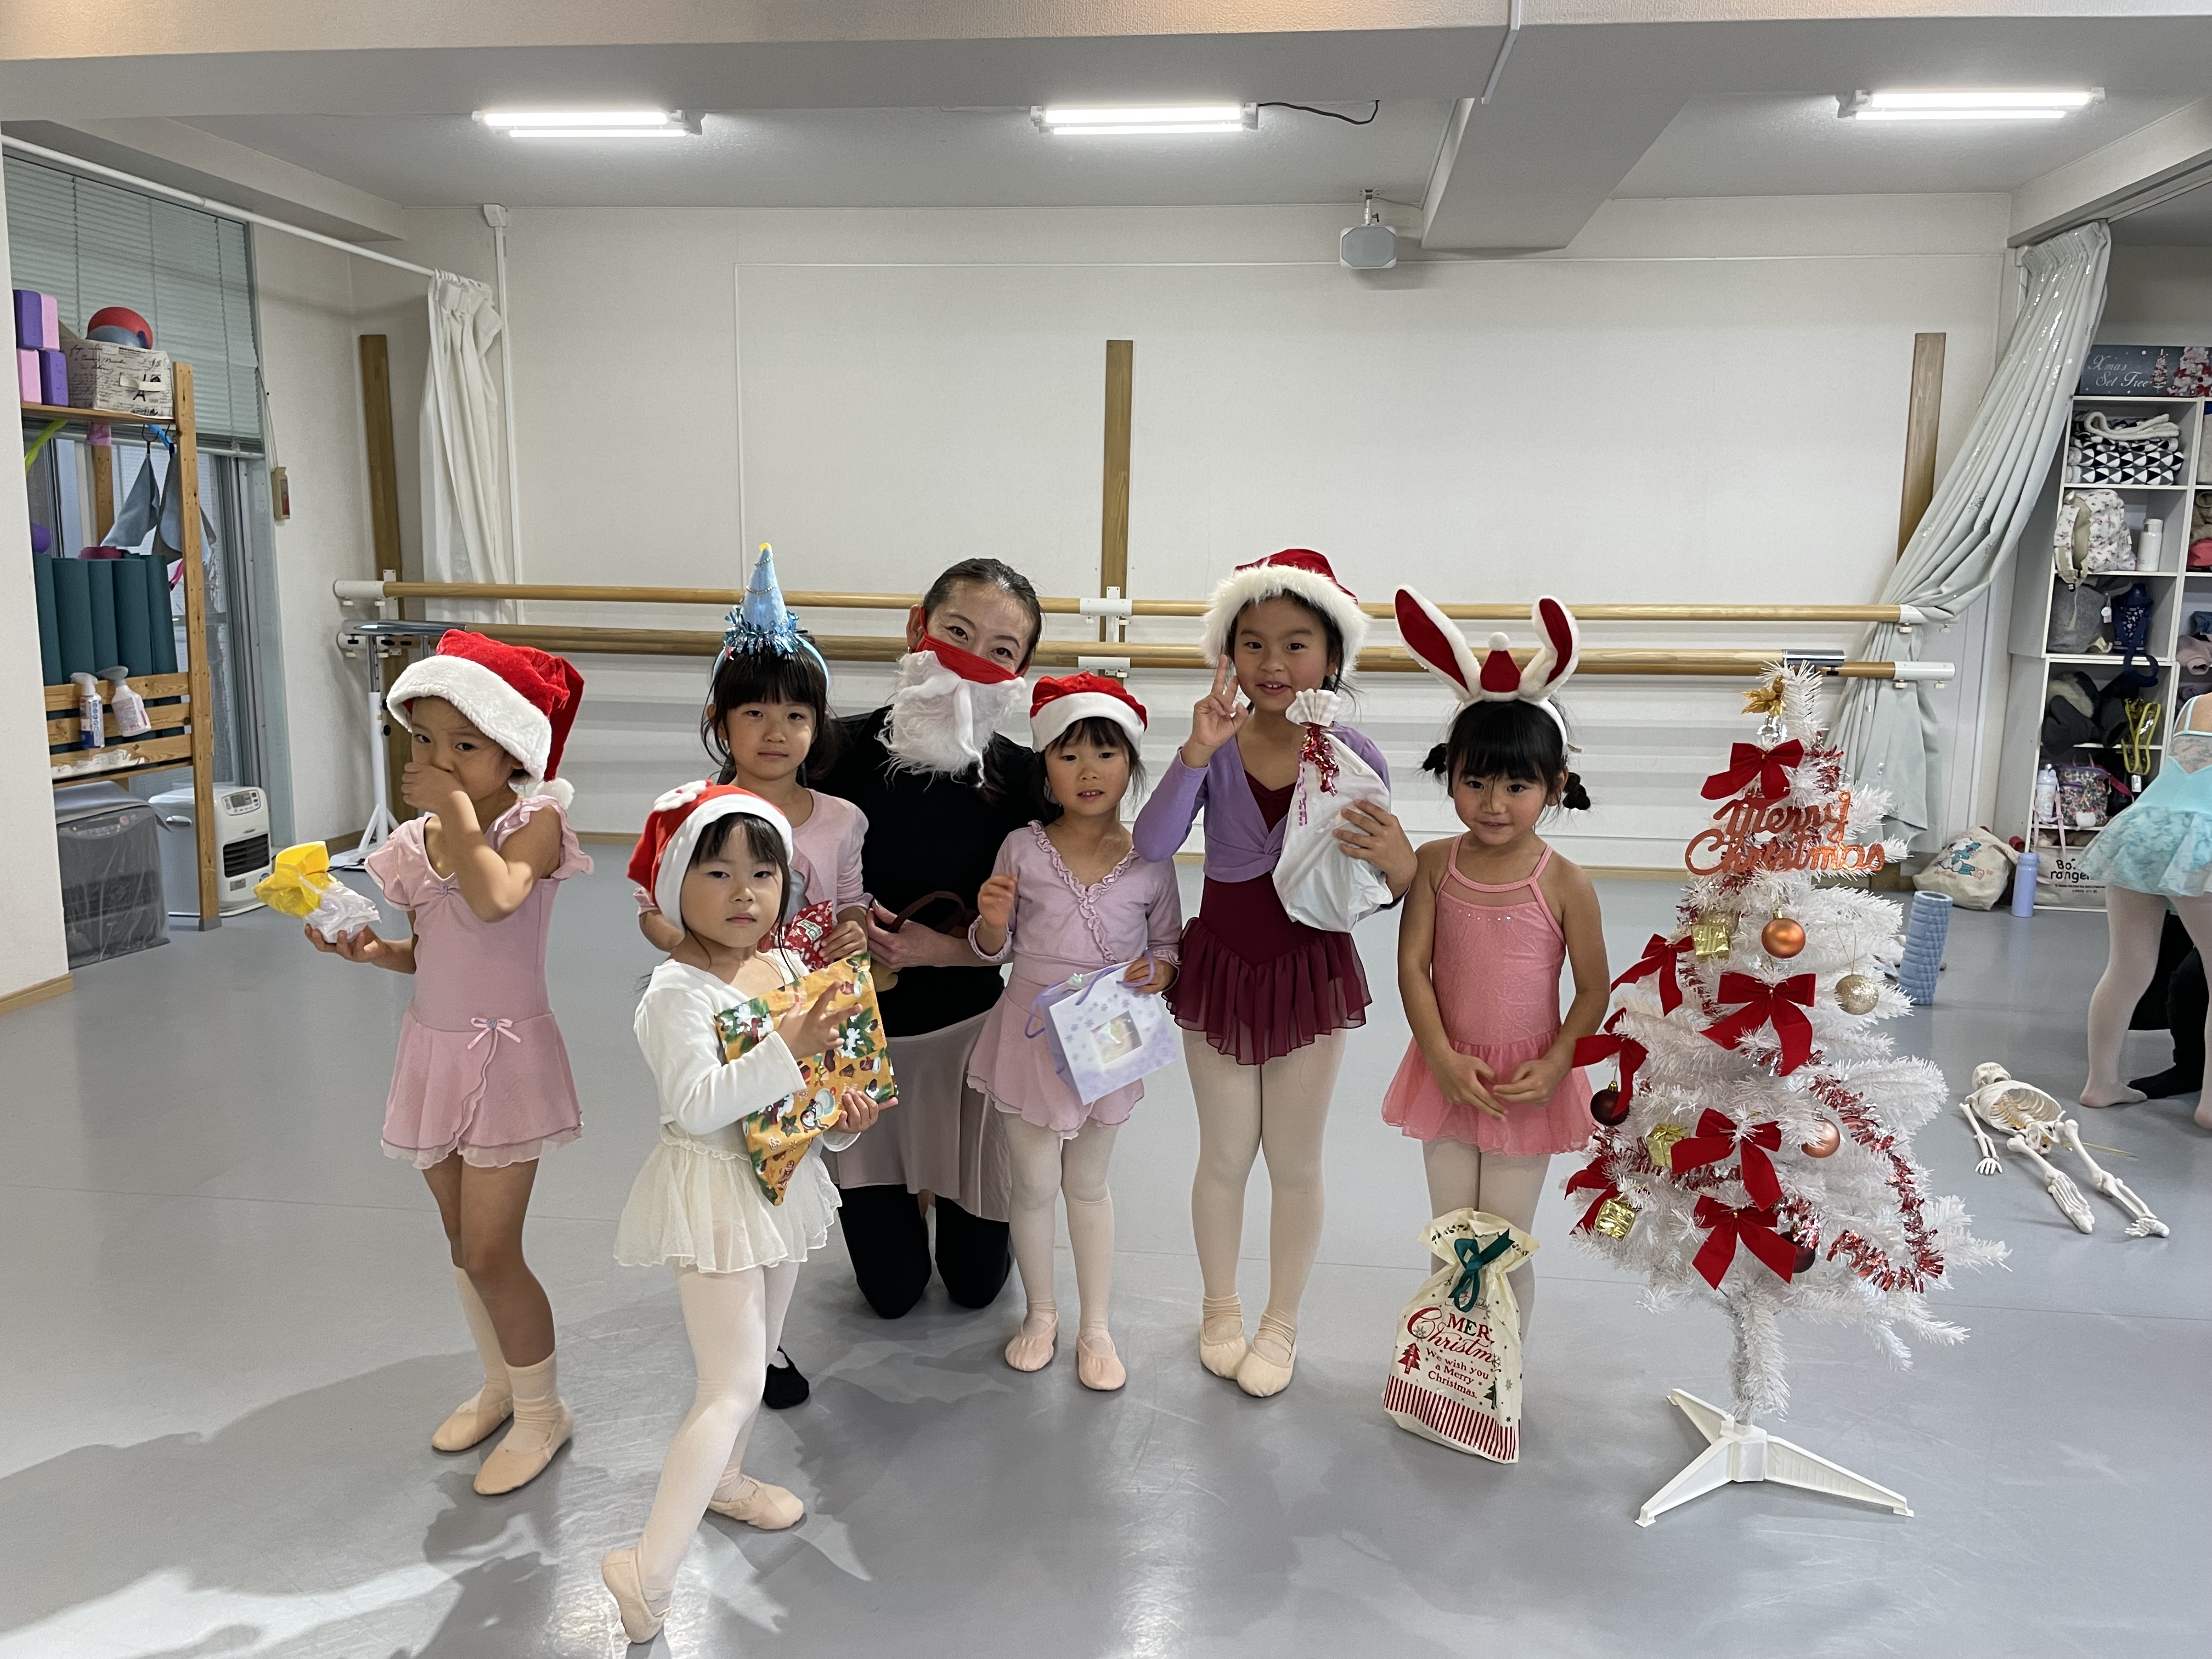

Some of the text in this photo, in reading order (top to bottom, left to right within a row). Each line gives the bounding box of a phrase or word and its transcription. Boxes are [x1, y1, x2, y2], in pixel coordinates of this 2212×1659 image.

[2088, 355, 2127, 371] Xmas
[2096, 371, 2150, 387] Set Tree
[1713, 789, 1850, 844] Merry
[1685, 827, 1886, 876] Christmas
[1426, 1347, 1442, 1362] We
[1444, 1358, 1467, 1371] wish
[1469, 1367, 1489, 1380] you
[1443, 1365, 1474, 1385] Merry
[1428, 1370, 1477, 1398] Christmas.
